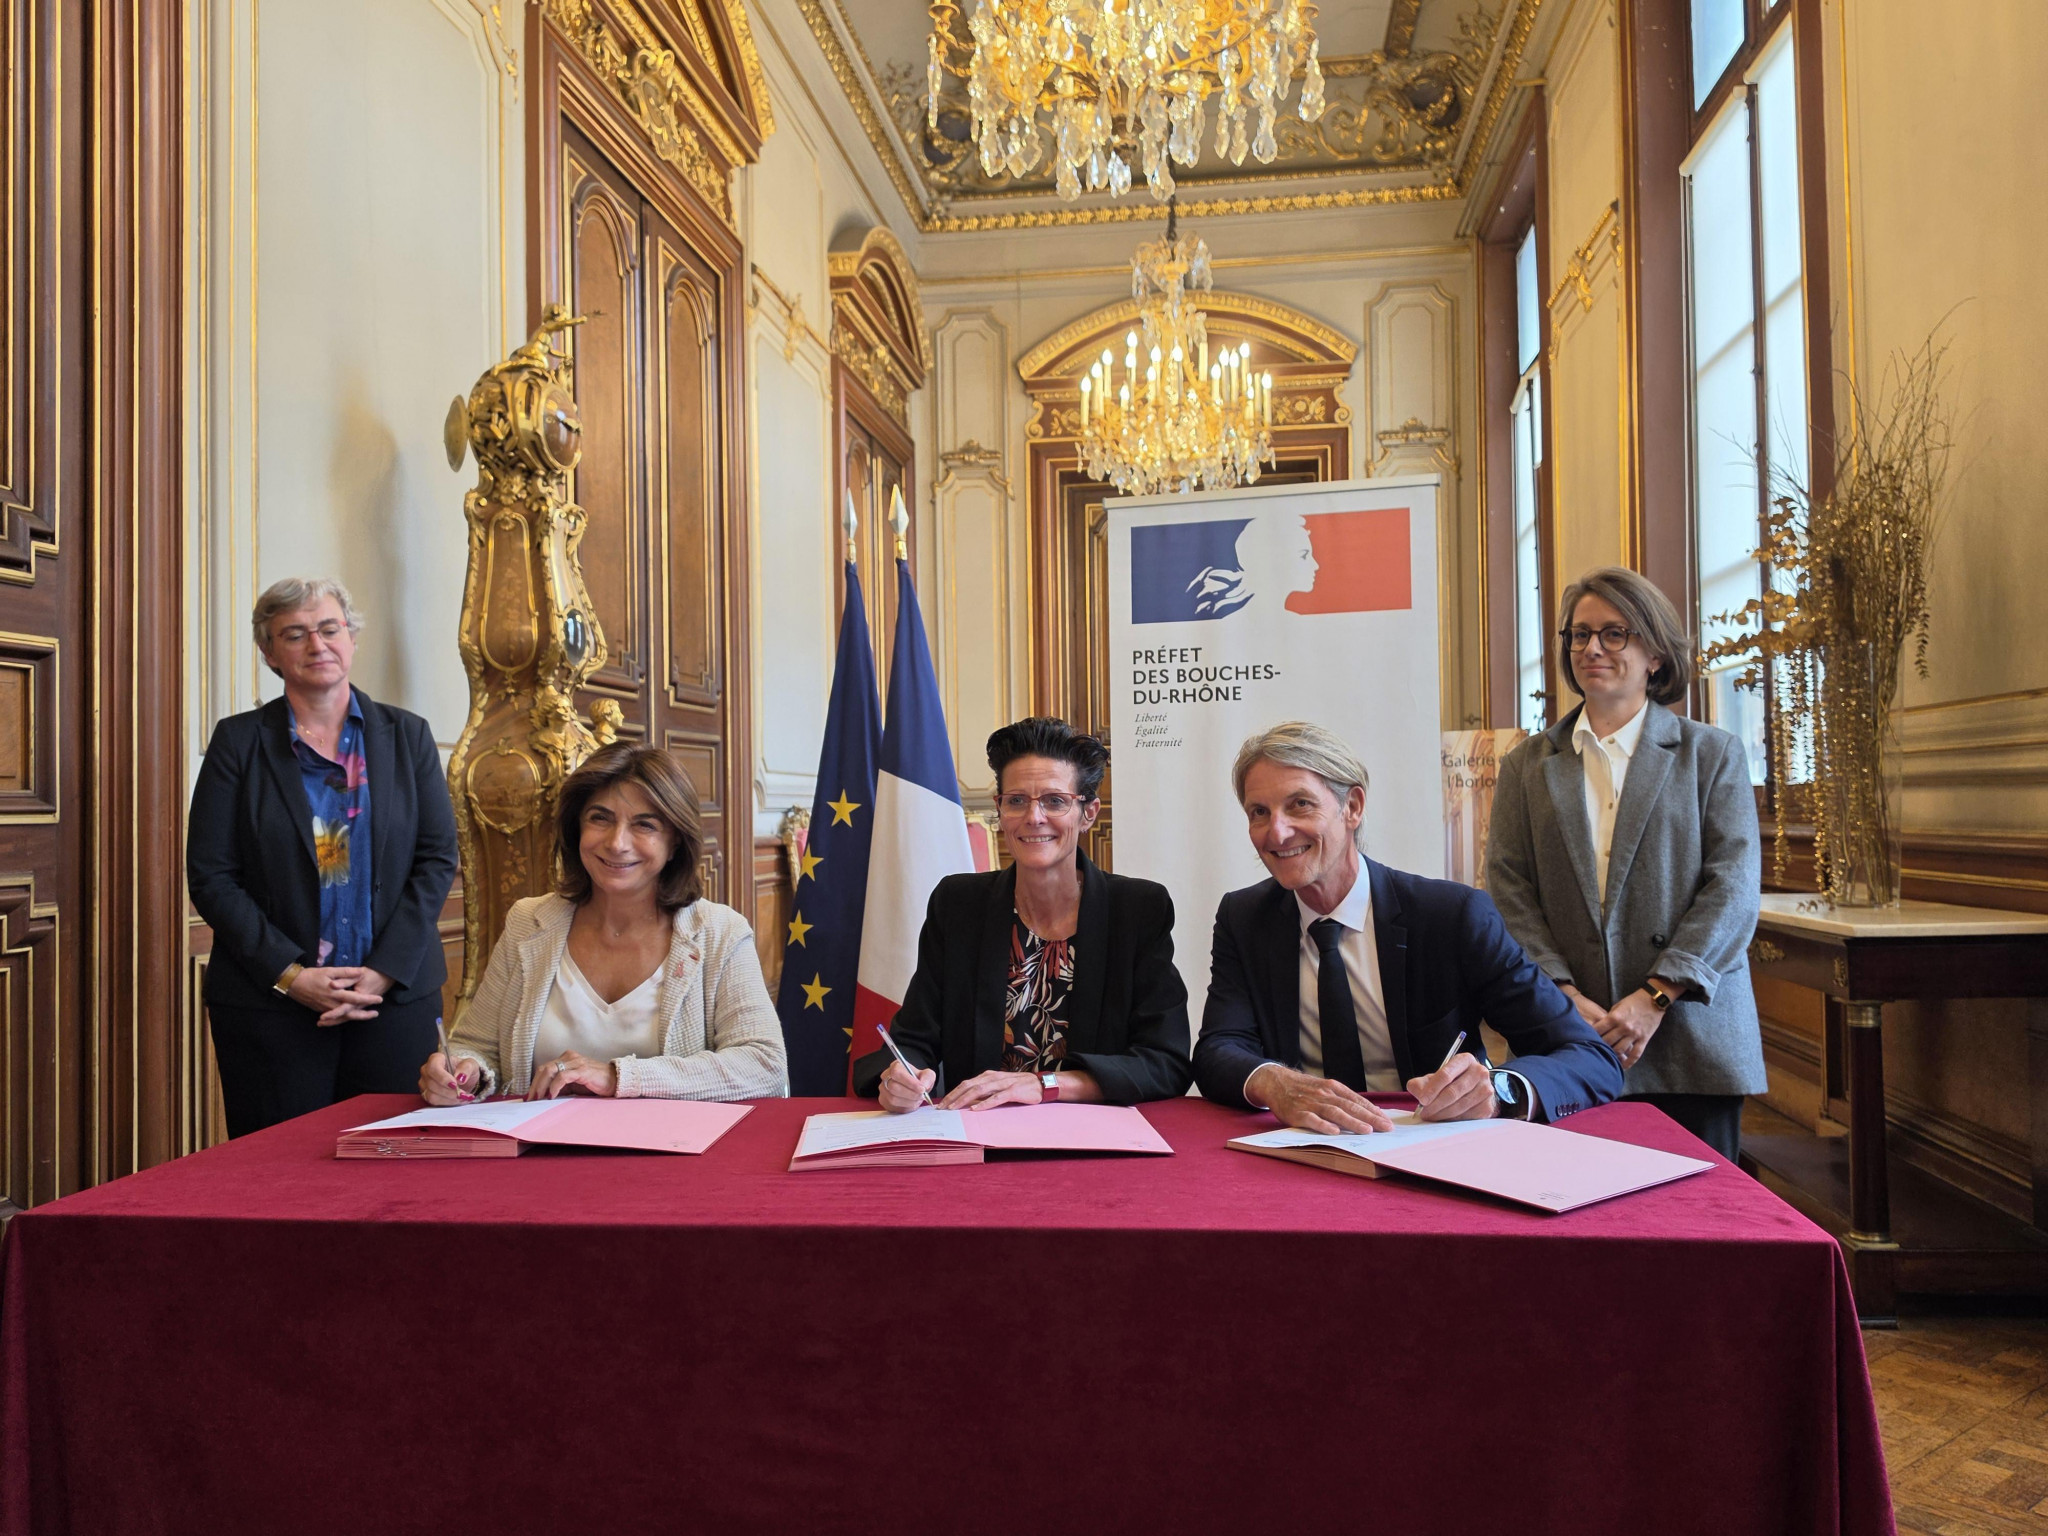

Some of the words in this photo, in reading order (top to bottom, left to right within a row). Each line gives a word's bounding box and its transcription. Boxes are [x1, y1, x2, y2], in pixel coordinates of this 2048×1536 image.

[1132, 645, 1203, 665] PRÉFET
[1133, 669, 1170, 685] DES
[1176, 664, 1281, 683] BOUCHES-
[1133, 683, 1242, 705] DU-RHÔNE
[1134, 712, 1168, 723] Liberté
[1134, 724, 1169, 738] Égalité
[1134, 737, 1183, 748] Fraternité
[1443, 753, 1495, 768] Galerie
[1447, 774, 1497, 789] l'horlo
